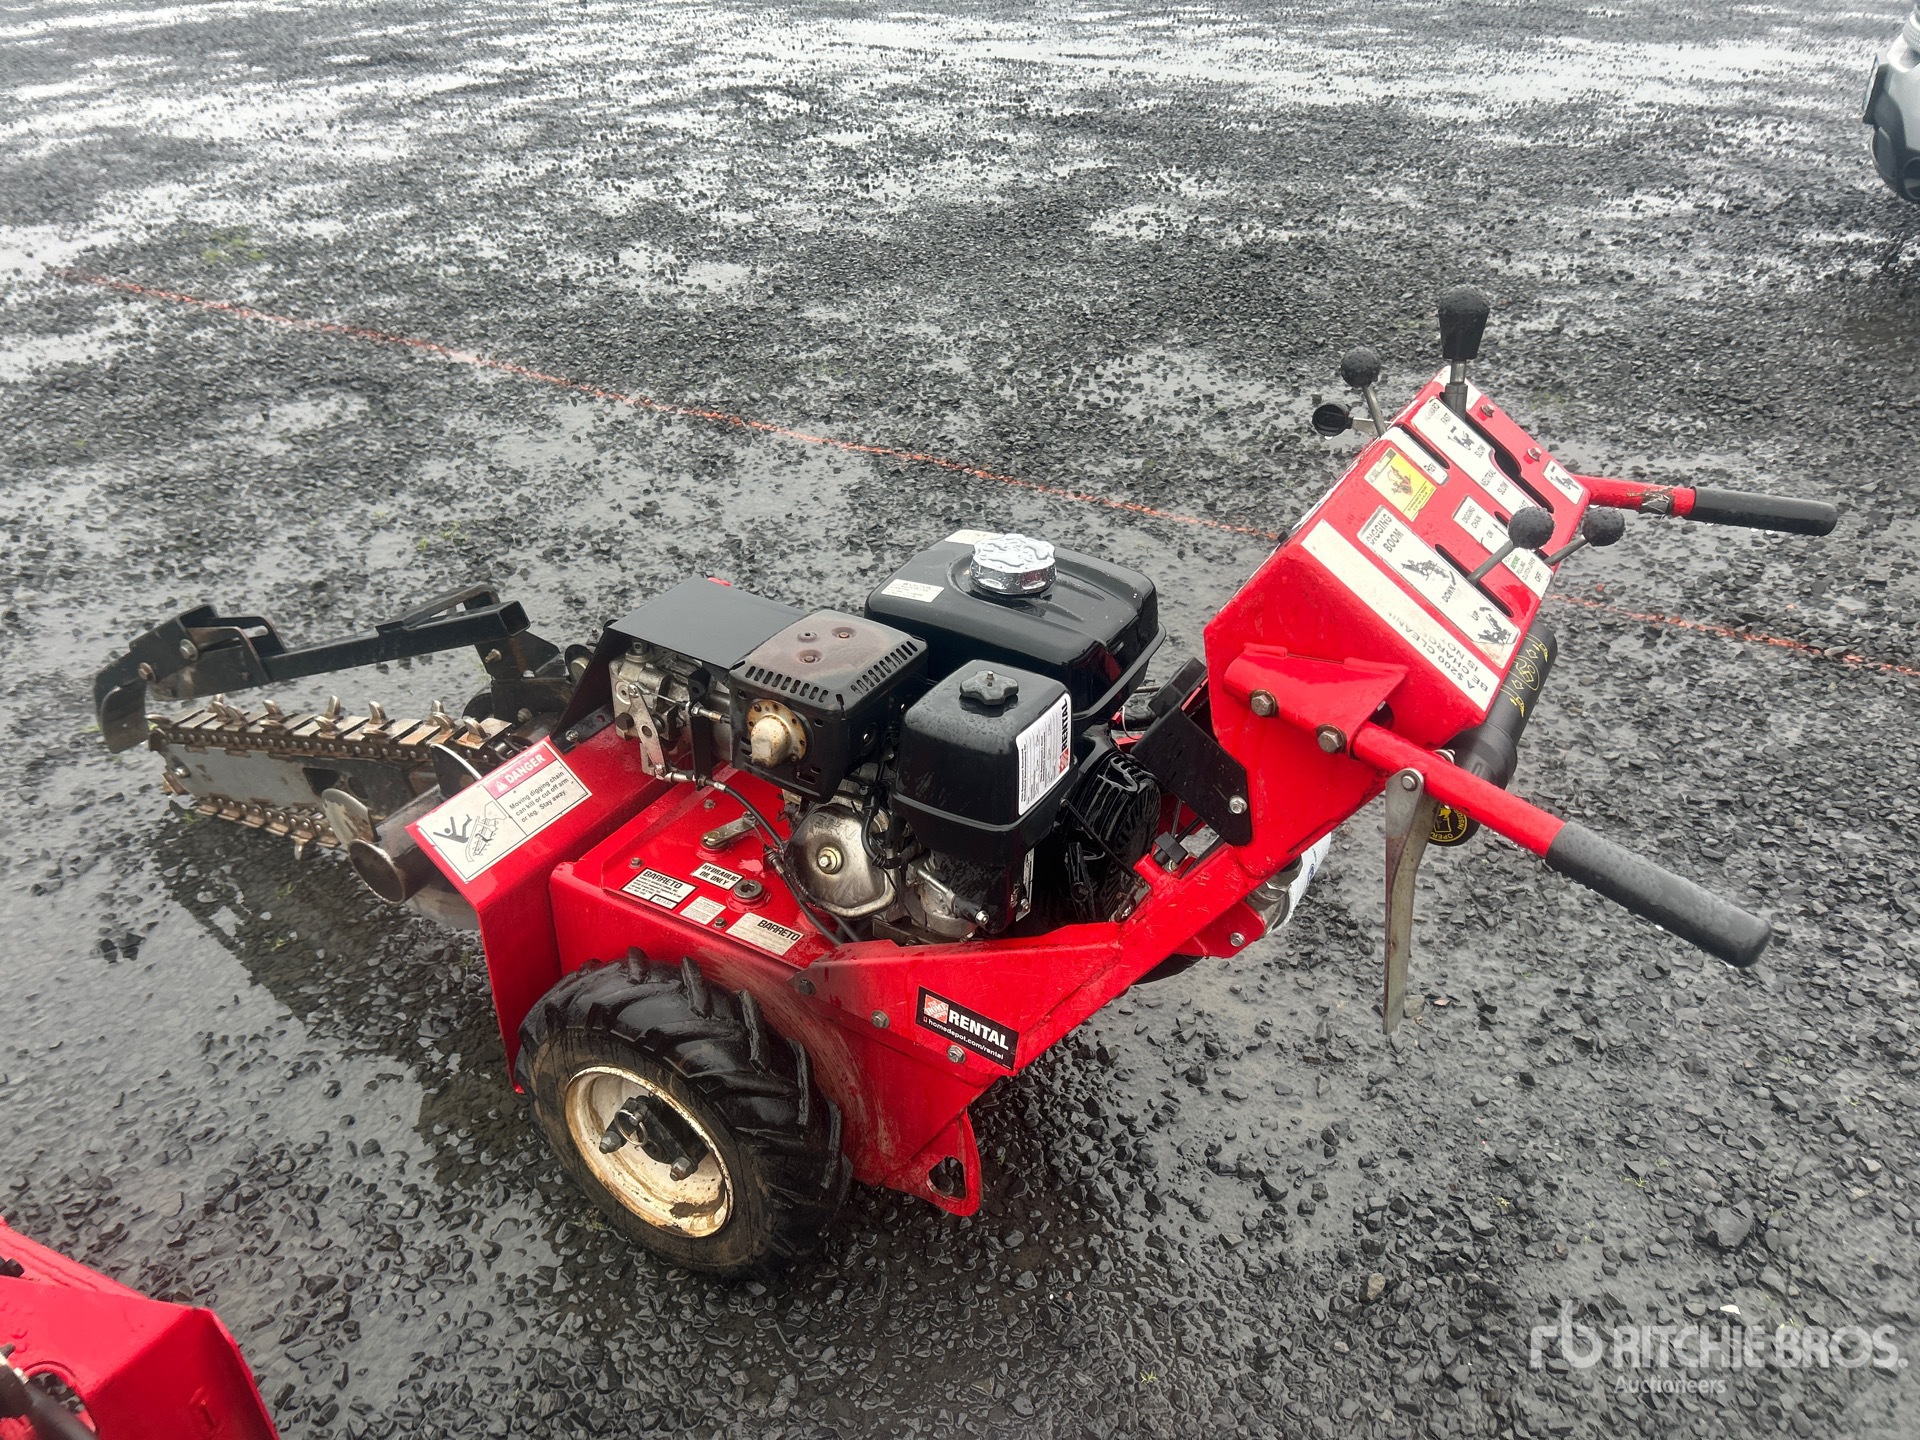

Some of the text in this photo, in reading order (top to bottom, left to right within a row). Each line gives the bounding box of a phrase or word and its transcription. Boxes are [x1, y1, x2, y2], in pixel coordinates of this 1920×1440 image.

[1480, 469, 1496, 487] NEUTRAL
[1366, 513, 1392, 546] DIGGING
[1382, 528, 1404, 553] BOOM
[1441, 584, 1456, 603] DOWN
[1471, 610, 1480, 621] UP
[1437, 655, 1464, 681] $200
[1467, 659, 1479, 672] IS
[1466, 679, 1476, 690] A
[1471, 674, 1489, 692] BE
[504, 754, 546, 784] DANGER
[509, 771, 565, 810] Moving digging chain
[515, 807, 527, 817] can
[525, 800, 535, 809] kill
[541, 789, 551, 799] cut
[550, 784, 559, 792] off
[558, 778, 569, 787] arm
[521, 815, 527, 823] or
[539, 799, 553, 810] Stay
[643, 870, 684, 889] BARRETO
[701, 864, 739, 882] HYDRAULIC
[710, 875, 730, 886] ONLY
[757, 919, 801, 942] BARRETO
[928, 1018, 1004, 1060] homedepot.com/rental
[948, 1009, 1009, 1050] RENTAL
